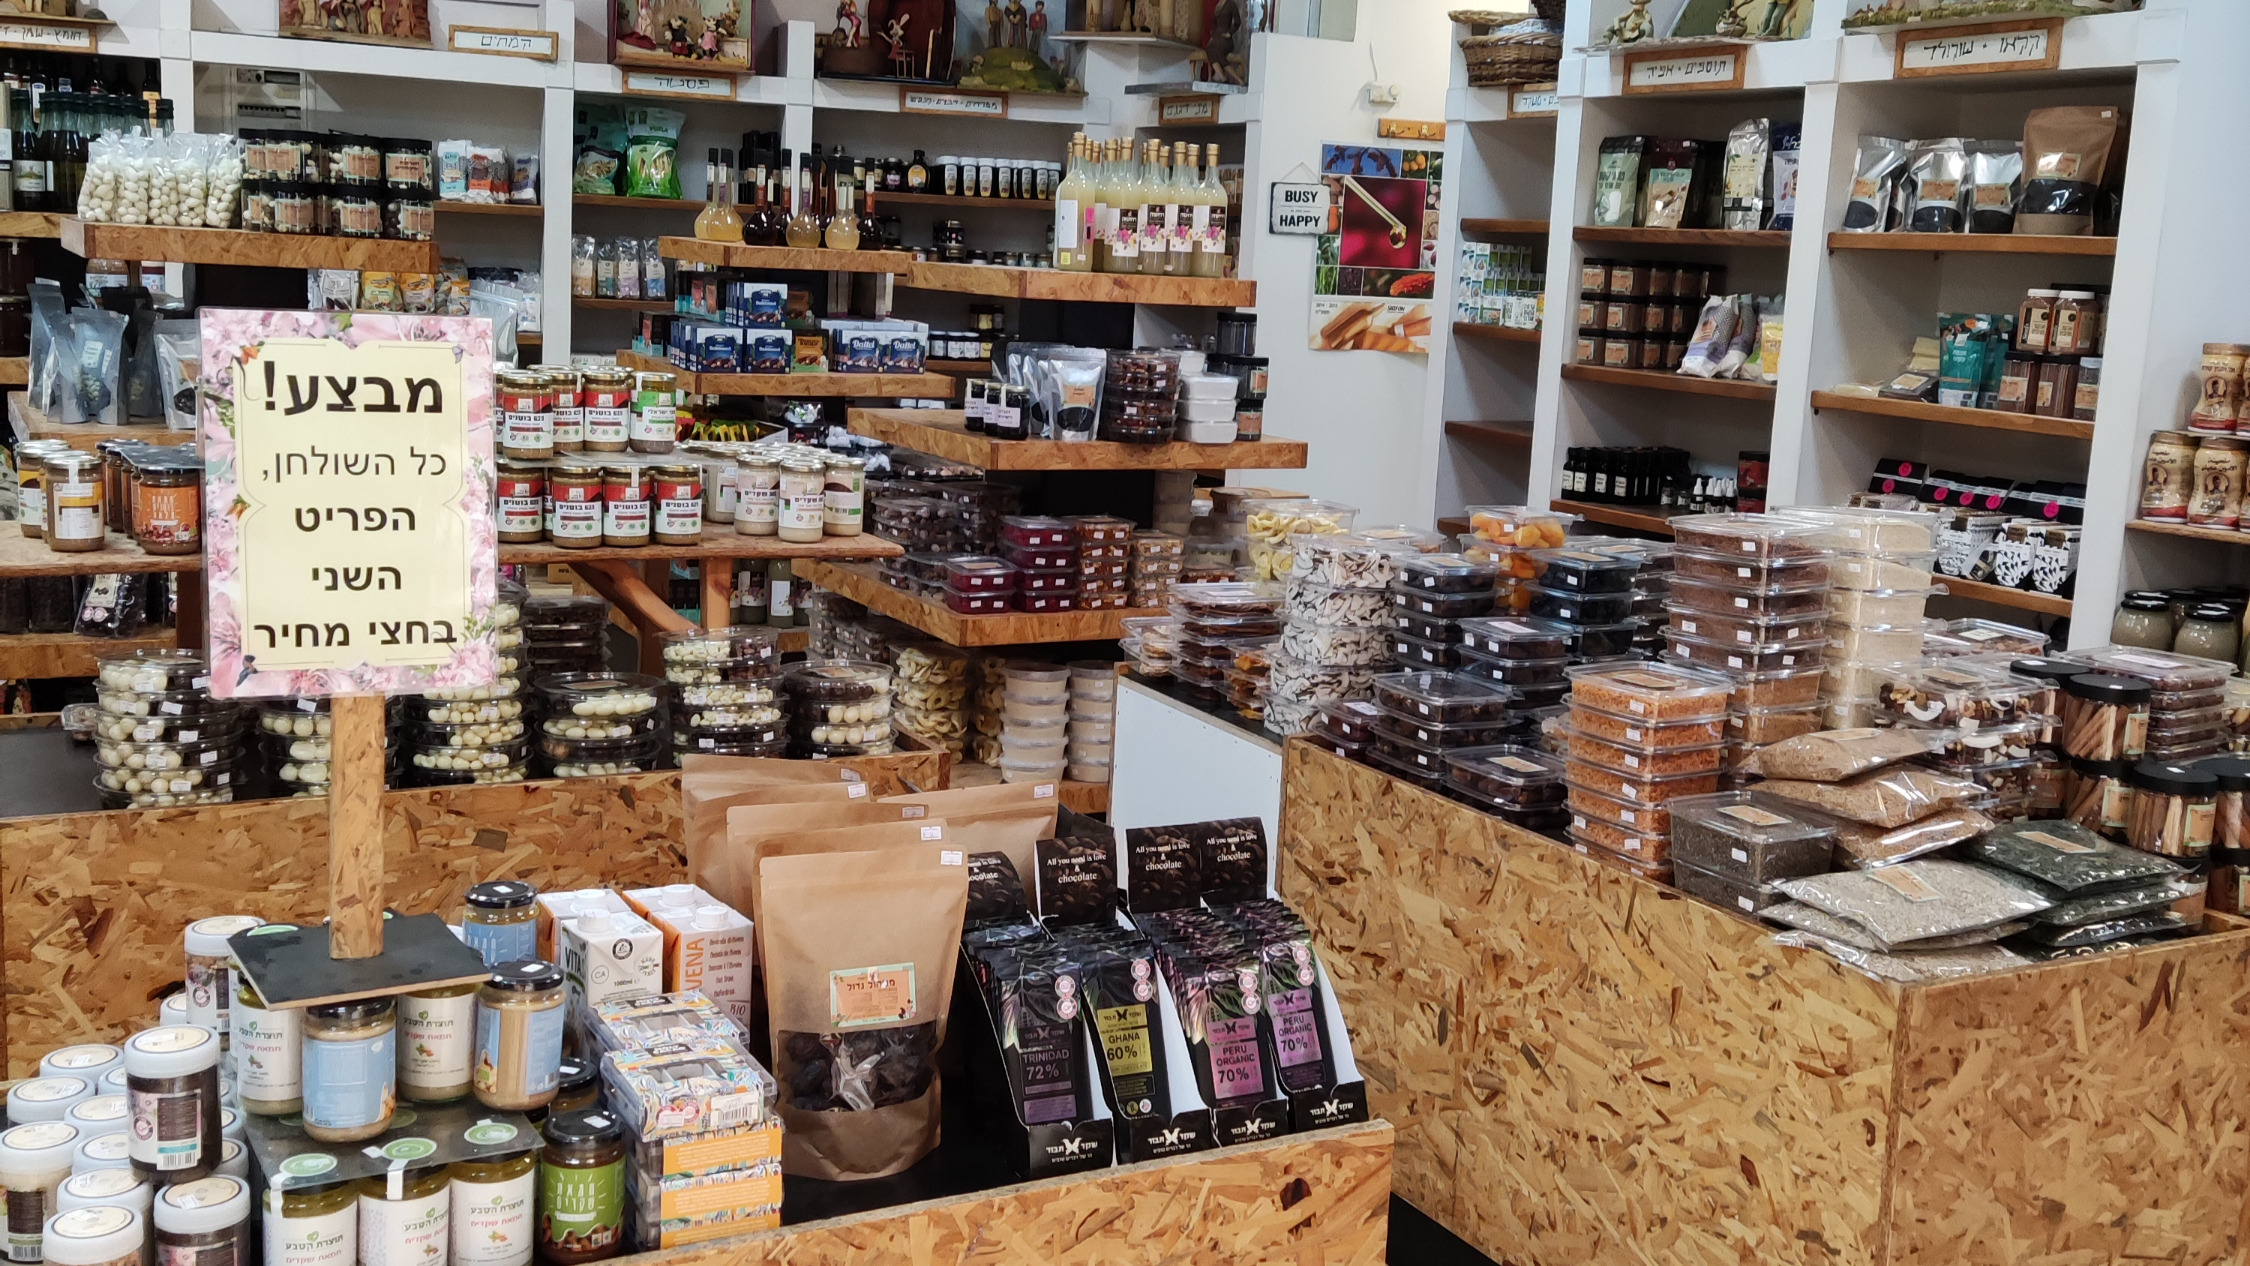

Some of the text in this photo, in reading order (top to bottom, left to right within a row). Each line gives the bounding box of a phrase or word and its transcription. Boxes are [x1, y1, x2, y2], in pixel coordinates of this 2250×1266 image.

[22, 26, 43, 40] שמן
[54, 28, 82, 43] חומץ
[481, 34, 532, 50] קמחים
[1923, 35, 2041, 62] קקאו שוקולד
[1646, 59, 1727, 79] תוספים אפיה
[654, 76, 710, 90] פסטה
[1285, 190, 1319, 203] BUSY
[1280, 214, 1321, 228] HAPPY
[262, 360, 443, 416] מבצע!
[508, 414, 532, 422] בוטנים
[261, 445, 447, 484] כל השולחן,
[294, 507, 416, 532] הפריט
[311, 566, 402, 591] השני
[253, 620, 458, 649] בחצי מחיר
[1135, 845, 1145, 854] All
[1146, 846, 1158, 855] you
[1158, 844, 1170, 852] need
[1177, 842, 1190, 850] love
[1215, 838, 1226, 847] you
[1046, 857, 1057, 866] All
[1058, 858, 1070, 867] you
[1071, 856, 1085, 865] need
[1092, 853, 1107, 862] love
[1217, 850, 1251, 863] chocolate
[1074, 865, 1081, 873] &
[1145, 859, 1182, 871] chocolate
[968, 871, 999, 882] ocolate
[1058, 871, 1098, 884] chocolate
[684, 937, 705, 991] VENA
[846, 982, 865, 992] גדול
[729, 1003, 746, 1016] BIO
[1283, 1014, 1305, 1026] PERU
[1278, 1023, 1313, 1037] ORGANIC
[1108, 1032, 1140, 1045] GHANA
[1281, 1036, 1308, 1053] 70%
[1022, 1049, 1070, 1064] TRINIDAD
[1107, 1044, 1138, 1061] 60%
[1222, 1044, 1247, 1056] PERU
[1216, 1053, 1255, 1067] ORGANIC
[1026, 1063, 1060, 1080] 72%
[1217, 1067, 1250, 1083] 70%
[1309, 1102, 1354, 1116] שקד תבור
[1230, 1121, 1276, 1135] שקד תבור
[1147, 1131, 1196, 1145] שקד תבור
[1045, 1141, 1098, 1154] שקד תבור
[556, 1182, 595, 1199] חמאת
[470, 1206, 498, 1215] הטבע
[556, 1197, 595, 1213] שקדים
[404, 1219, 431, 1232] הטבע
[470, 1213, 523, 1229] חמאת שקדים
[285, 1234, 344, 1252] תוצרת הטבע
[405, 1233, 432, 1245] שקדים
[286, 1248, 343, 1265] חמאת שקדים
